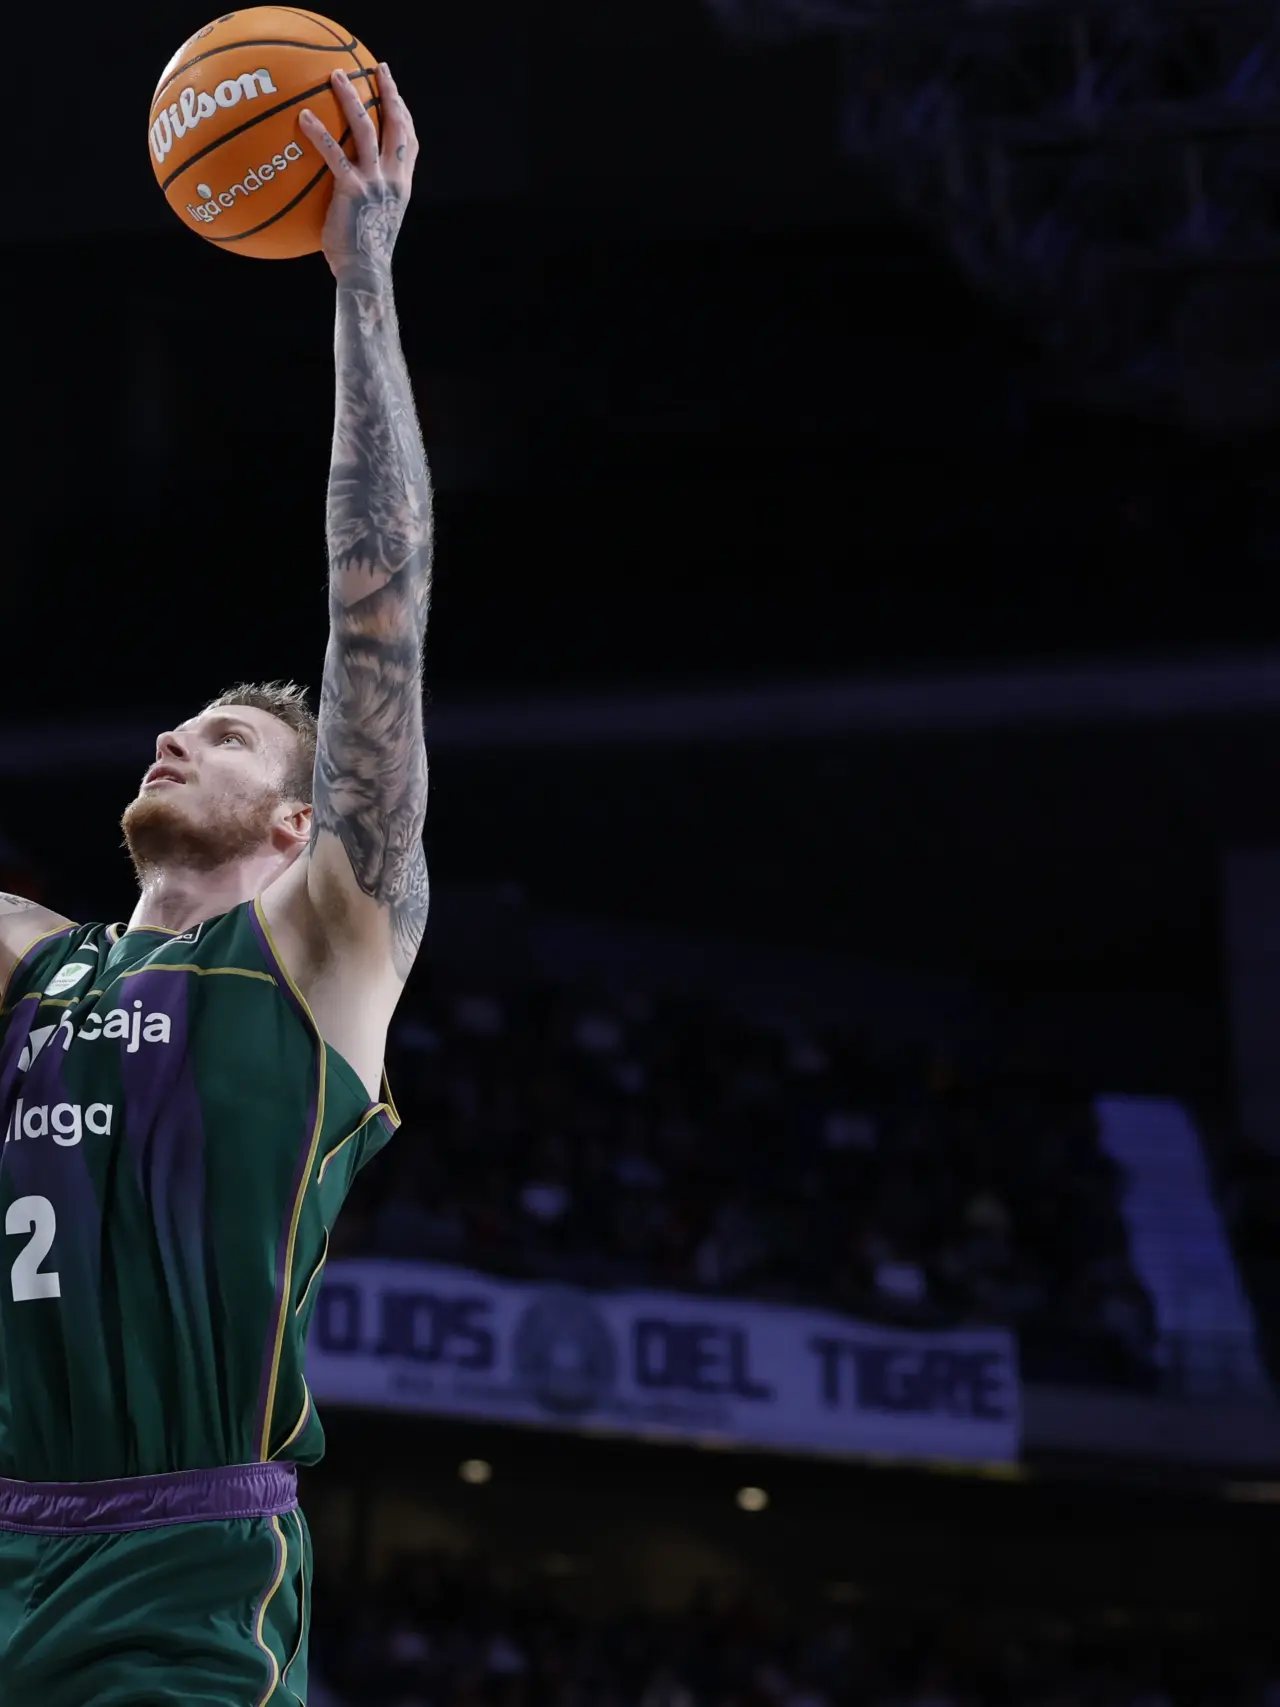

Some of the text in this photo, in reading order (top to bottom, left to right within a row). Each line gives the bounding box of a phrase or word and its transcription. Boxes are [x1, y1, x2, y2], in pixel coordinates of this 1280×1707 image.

[150, 69, 277, 164] Wilson
[186, 141, 304, 223] liga endesa
[5, 1097, 113, 1147] laga
[4, 1194, 62, 1302] 2
[316, 1283, 1005, 1421] OJOS DEL TIGRE
